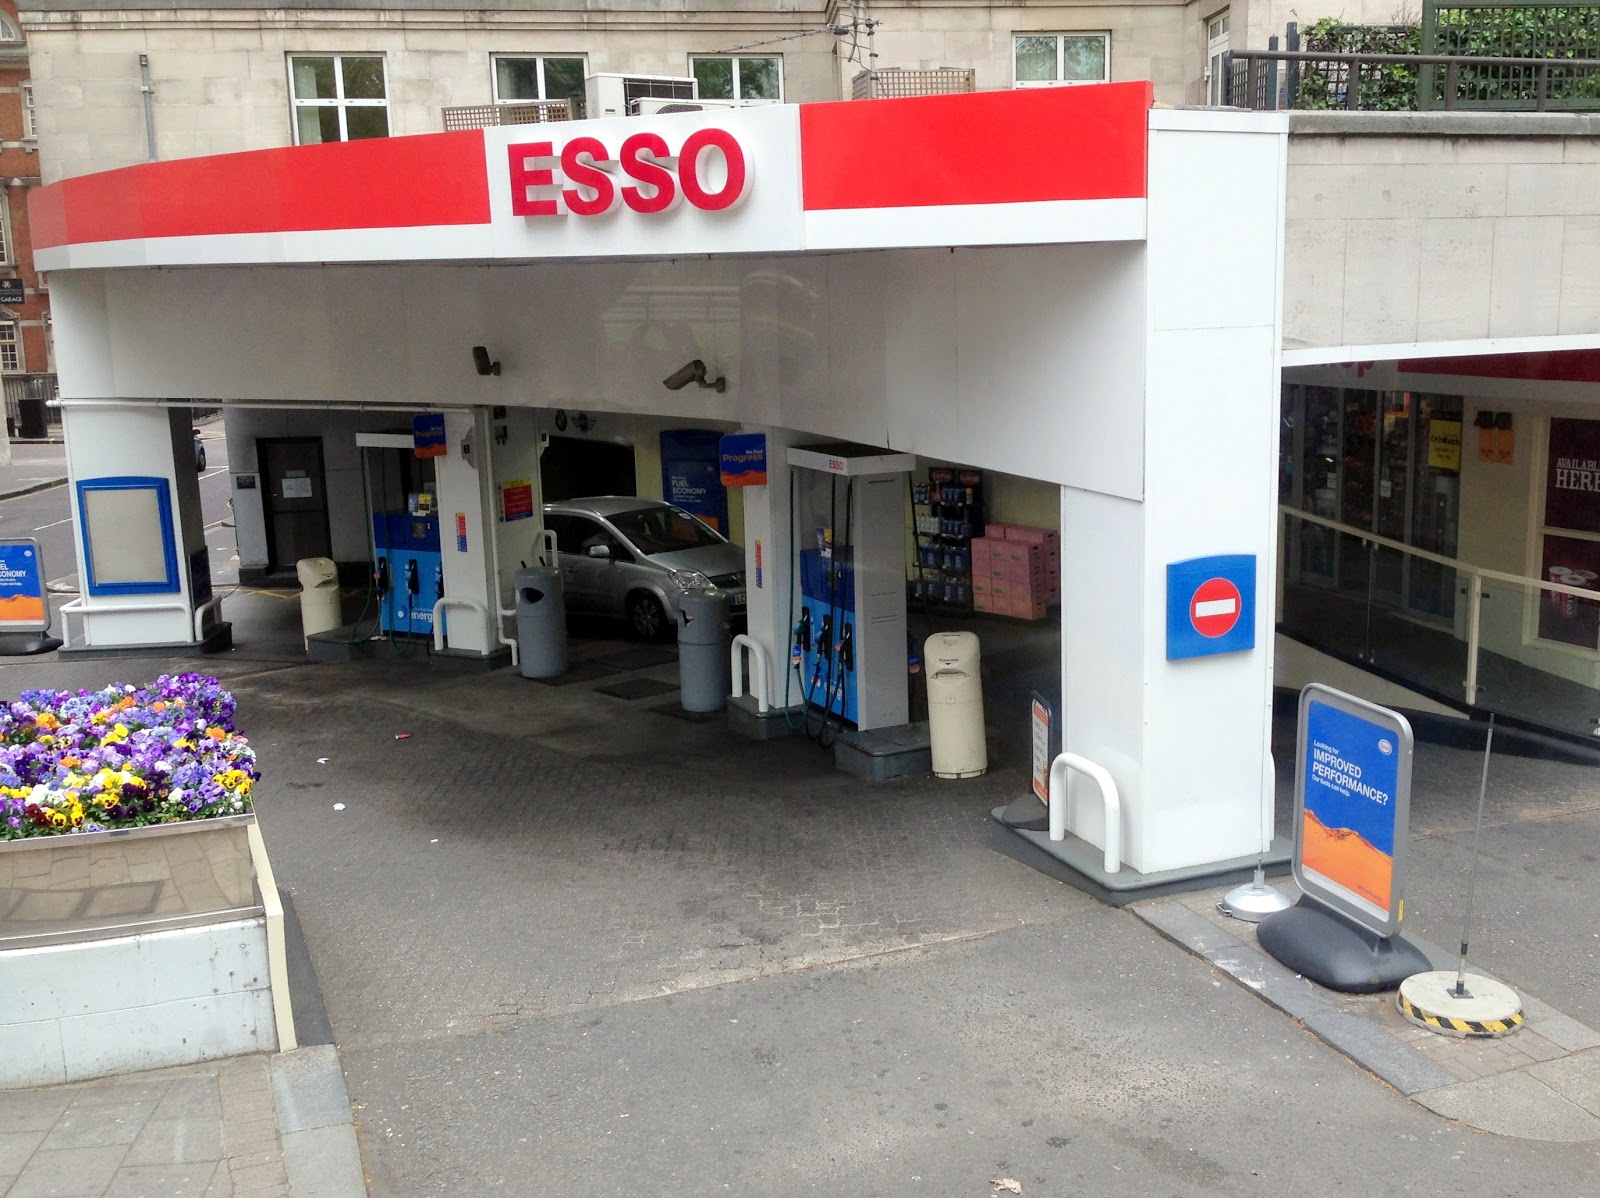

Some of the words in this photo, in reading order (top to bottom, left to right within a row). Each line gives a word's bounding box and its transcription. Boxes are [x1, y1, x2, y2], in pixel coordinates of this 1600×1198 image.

[508, 128, 747, 217] ESSO
[722, 453, 763, 463] Progress
[828, 459, 844, 471] ESSO
[1556, 457, 1600, 471] AVAILABL
[1555, 468, 1600, 492] HERE
[673, 487, 707, 495] ECONOMY
[411, 611, 433, 623] energ
[1313, 740, 1332, 754] Looking
[1314, 748, 1362, 779] IMPROVED
[1312, 761, 1389, 806] PERFORMANCE?
[1312, 774, 1320, 783] Our
[1320, 777, 1331, 788] fuels
[1331, 783, 1340, 792] can
[1340, 787, 1351, 797] help.
